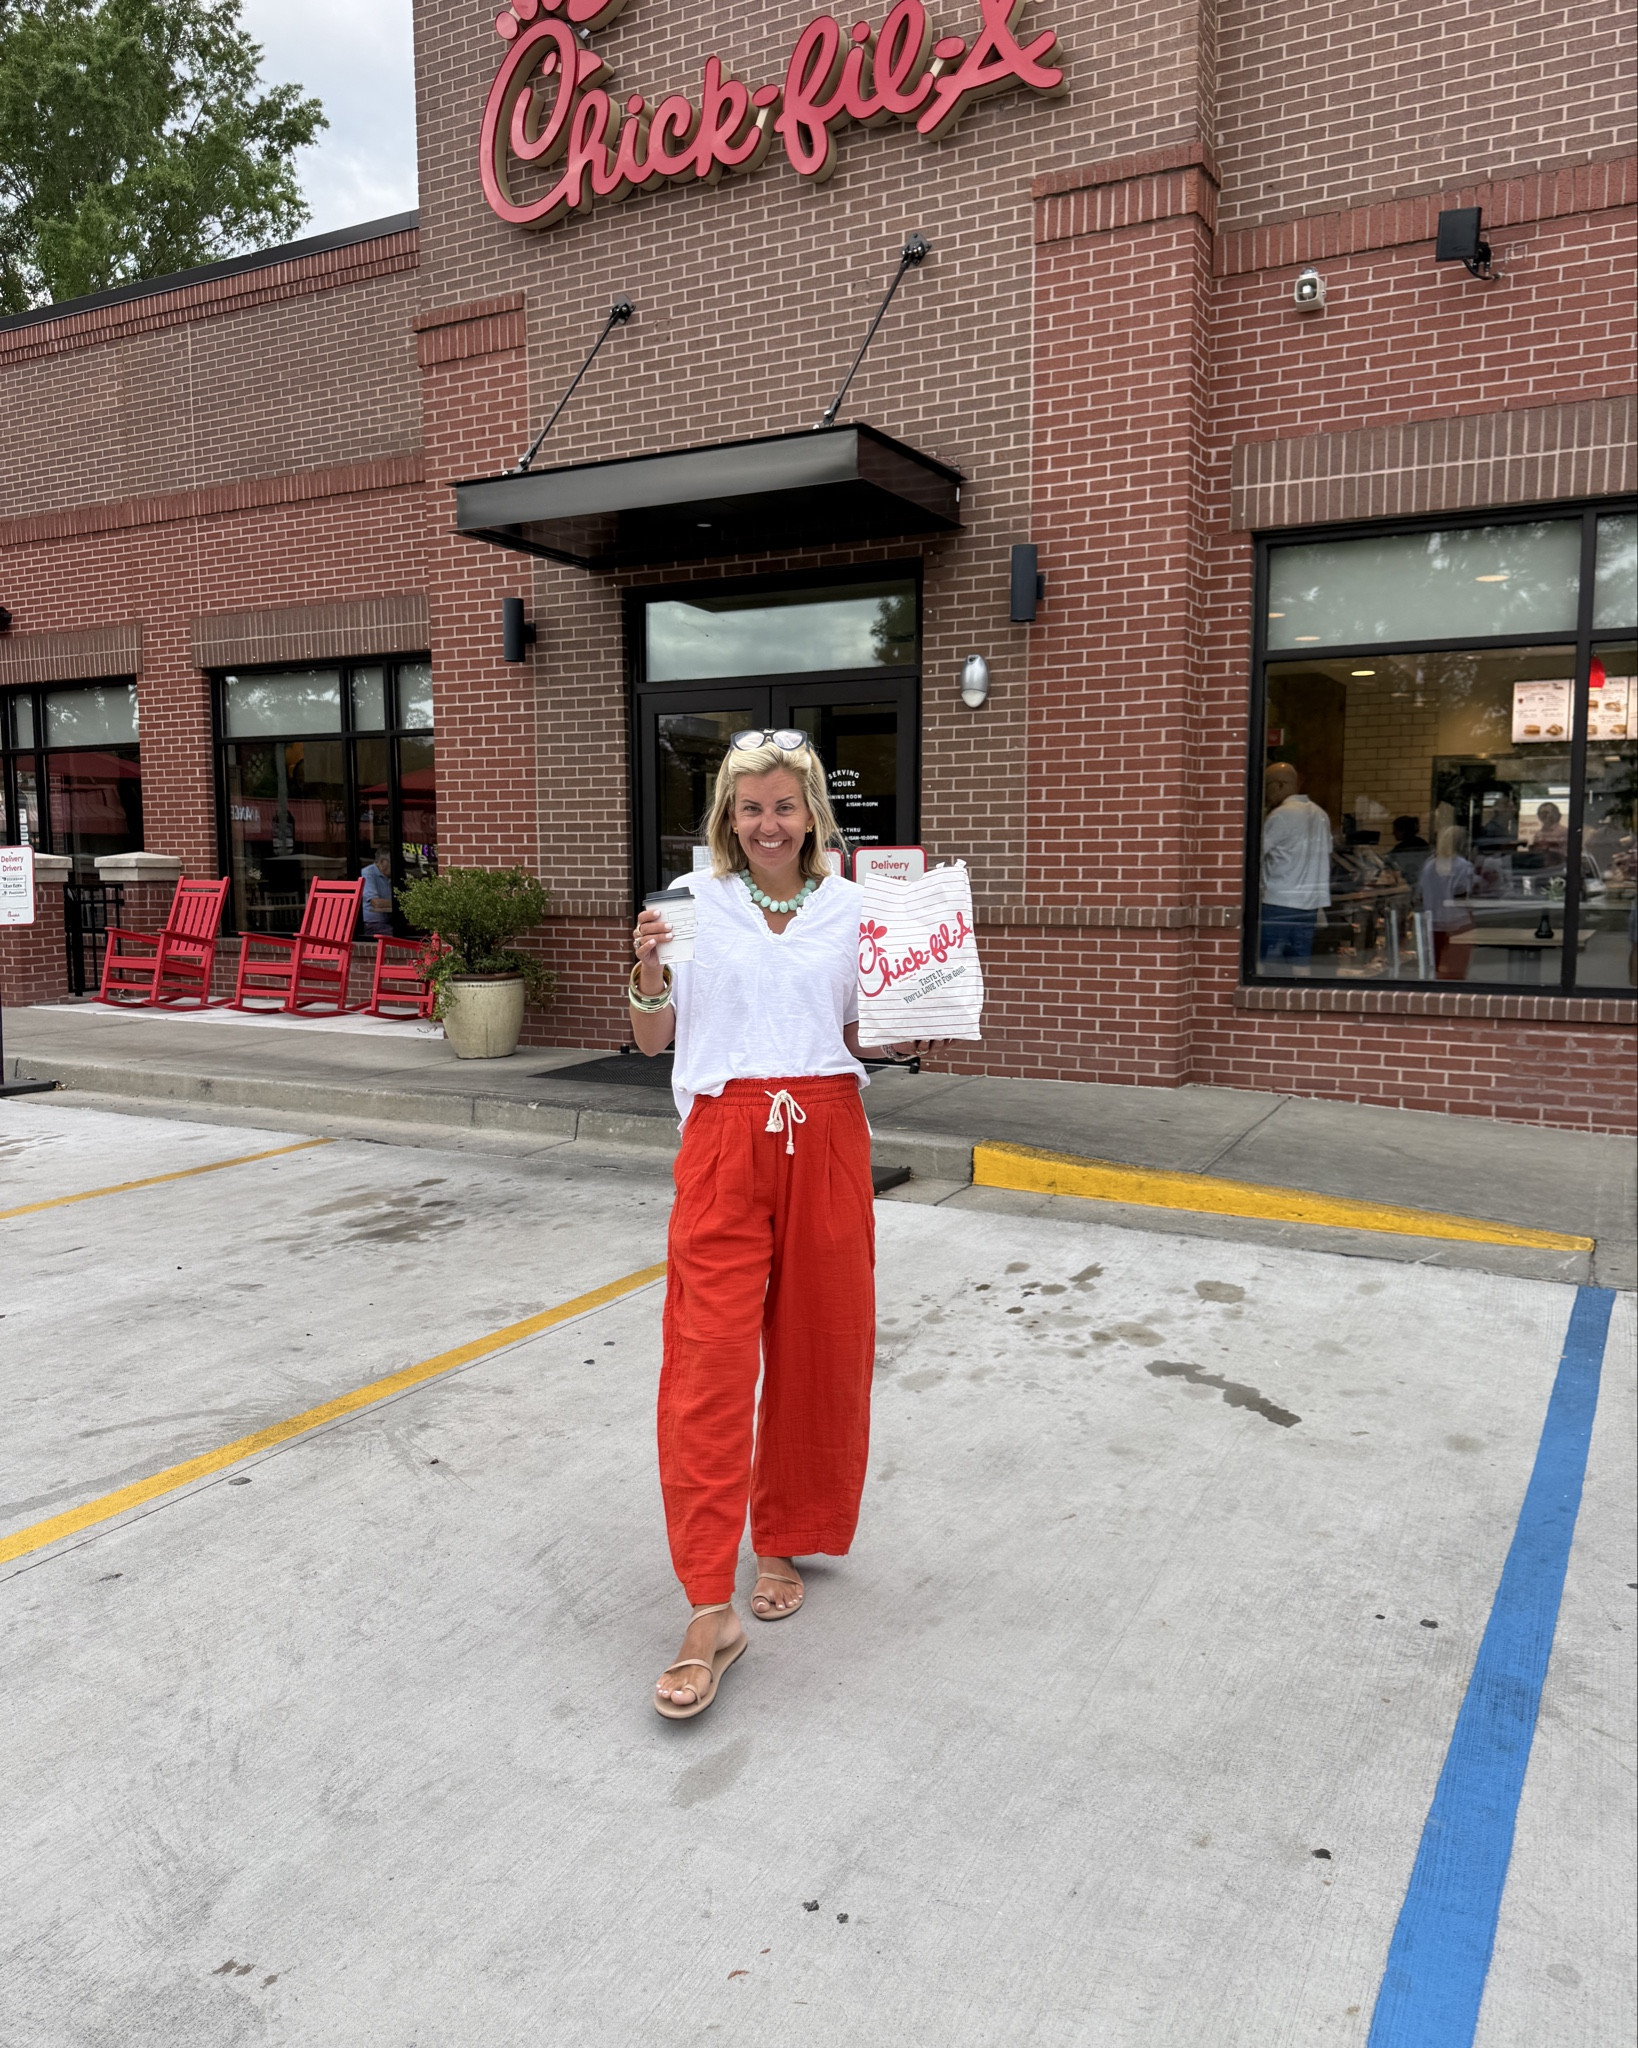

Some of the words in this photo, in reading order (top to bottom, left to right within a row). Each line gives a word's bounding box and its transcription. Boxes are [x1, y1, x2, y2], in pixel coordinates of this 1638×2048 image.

[479, 0, 1064, 225] Chick-fil-A
[828, 769, 860, 779] SERVING
[1, 855, 24, 863] Delivery
[871, 860, 909, 871] Delivery
[858, 911, 973, 997] Chick-fil-A
[919, 974, 938, 986] TASTE
[922, 982, 937, 995] LOVE
[935, 979, 943, 987] IT
[941, 973, 953, 984] FOR
